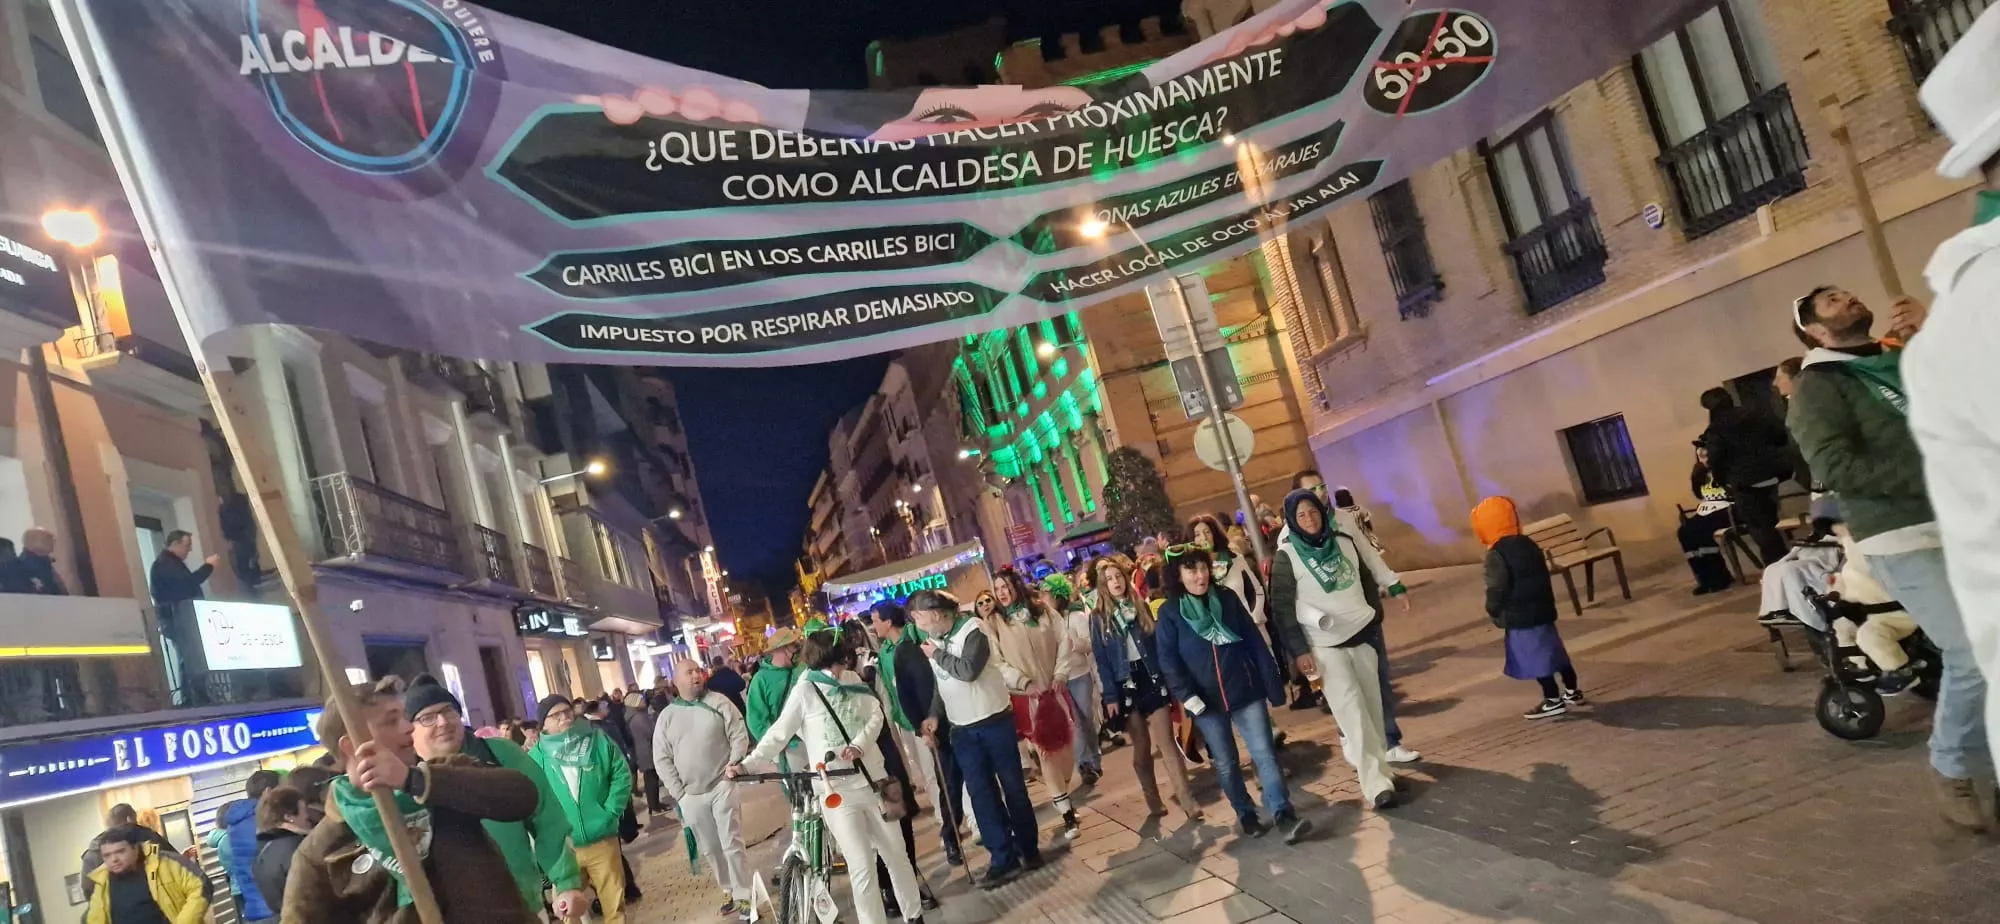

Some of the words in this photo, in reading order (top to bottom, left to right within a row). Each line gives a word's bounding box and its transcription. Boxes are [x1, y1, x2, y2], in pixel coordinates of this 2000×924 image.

[239, 26, 456, 75] ALCALD
[442, 0, 495, 63] QUIERE
[645, 129, 739, 172] ¿QUE
[1046, 47, 1283, 131] PRÓXIMAMENTE
[722, 171, 838, 200] COMO
[849, 151, 1042, 195] ALCALDESA
[1053, 142, 1094, 174] DE
[1103, 106, 1228, 165] HUESCA?
[1092, 199, 1152, 227] ONAS
[1154, 176, 1220, 212] AZULES
[1224, 169, 1244, 189] EN
[562, 260, 666, 287] CARRILES
[669, 251, 715, 278] BICI
[721, 248, 754, 271] EN
[759, 248, 803, 265] LOS
[807, 236, 908, 263] CARRILES
[915, 233, 955, 253] BICI
[1050, 268, 1120, 294] HACER
[1118, 247, 1184, 277] LOCAL
[1182, 236, 1212, 254] DE
[1212, 218, 1261, 242] OCIO
[1264, 207, 1291, 222] AL
[1289, 195, 1318, 212] JAI
[1318, 171, 1361, 199] ALAI
[580, 323, 695, 344] IMPUESTO
[701, 323, 748, 345] POR
[751, 307, 851, 339] RESPIRAR
[854, 290, 975, 323] DEMASIADO
[113, 739, 151, 771] EL
[163, 722, 252, 763] FOSKO
